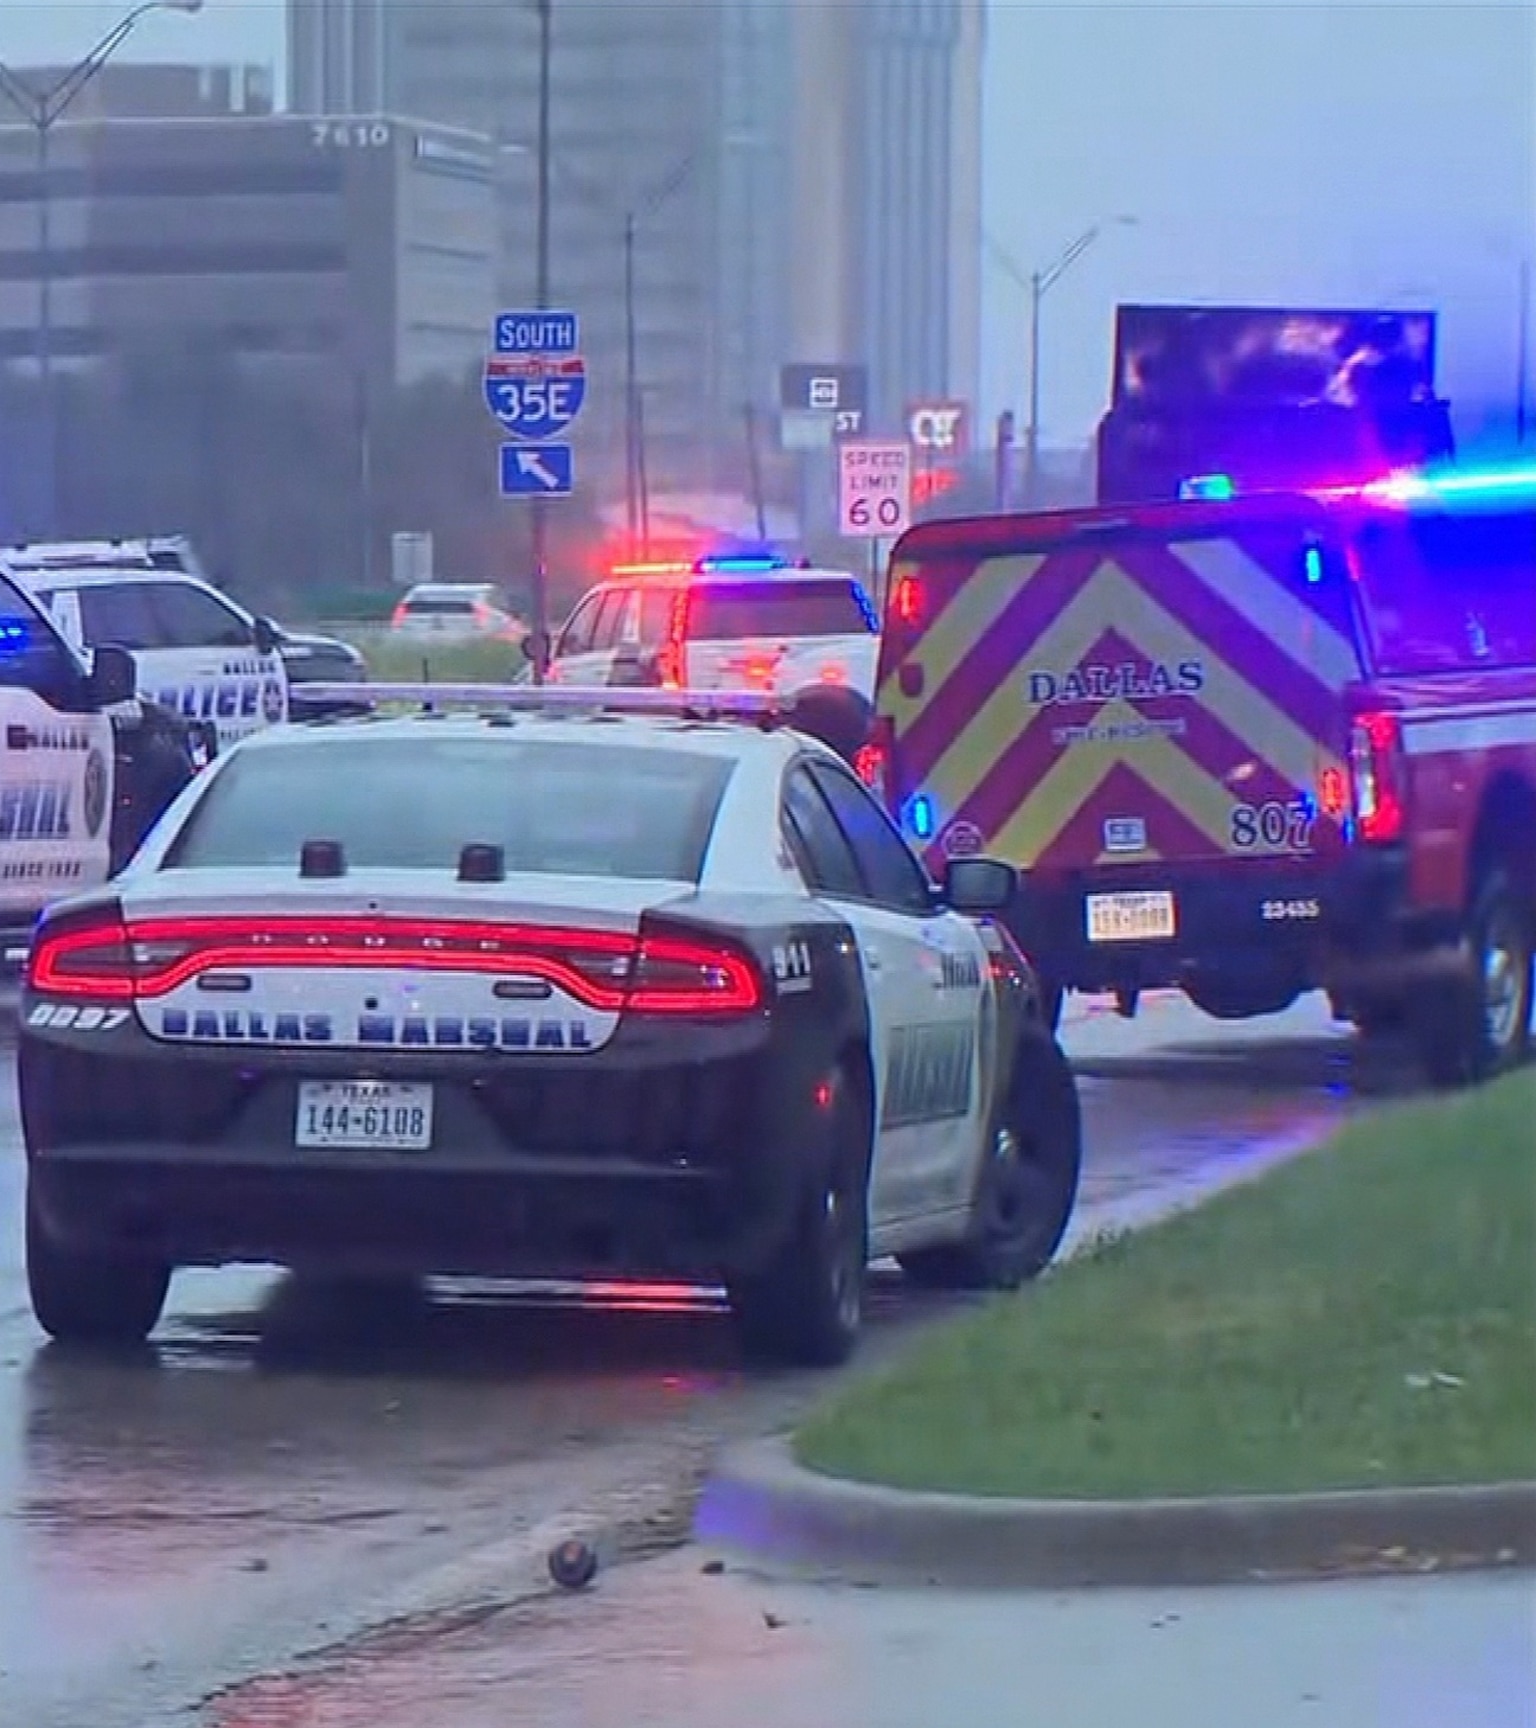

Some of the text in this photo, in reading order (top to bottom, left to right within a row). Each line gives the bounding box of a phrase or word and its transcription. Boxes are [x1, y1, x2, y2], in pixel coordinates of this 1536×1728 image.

[500, 320, 571, 348] SOUTH
[496, 384, 571, 422] 35E
[844, 452, 904, 466] SPEED
[850, 475, 897, 490] LIMIT
[849, 498, 900, 526] 60
[1028, 661, 1204, 706] DALLAS
[1231, 801, 1314, 850] 807
[162, 1009, 592, 1048] DALLAS MARSHAL
